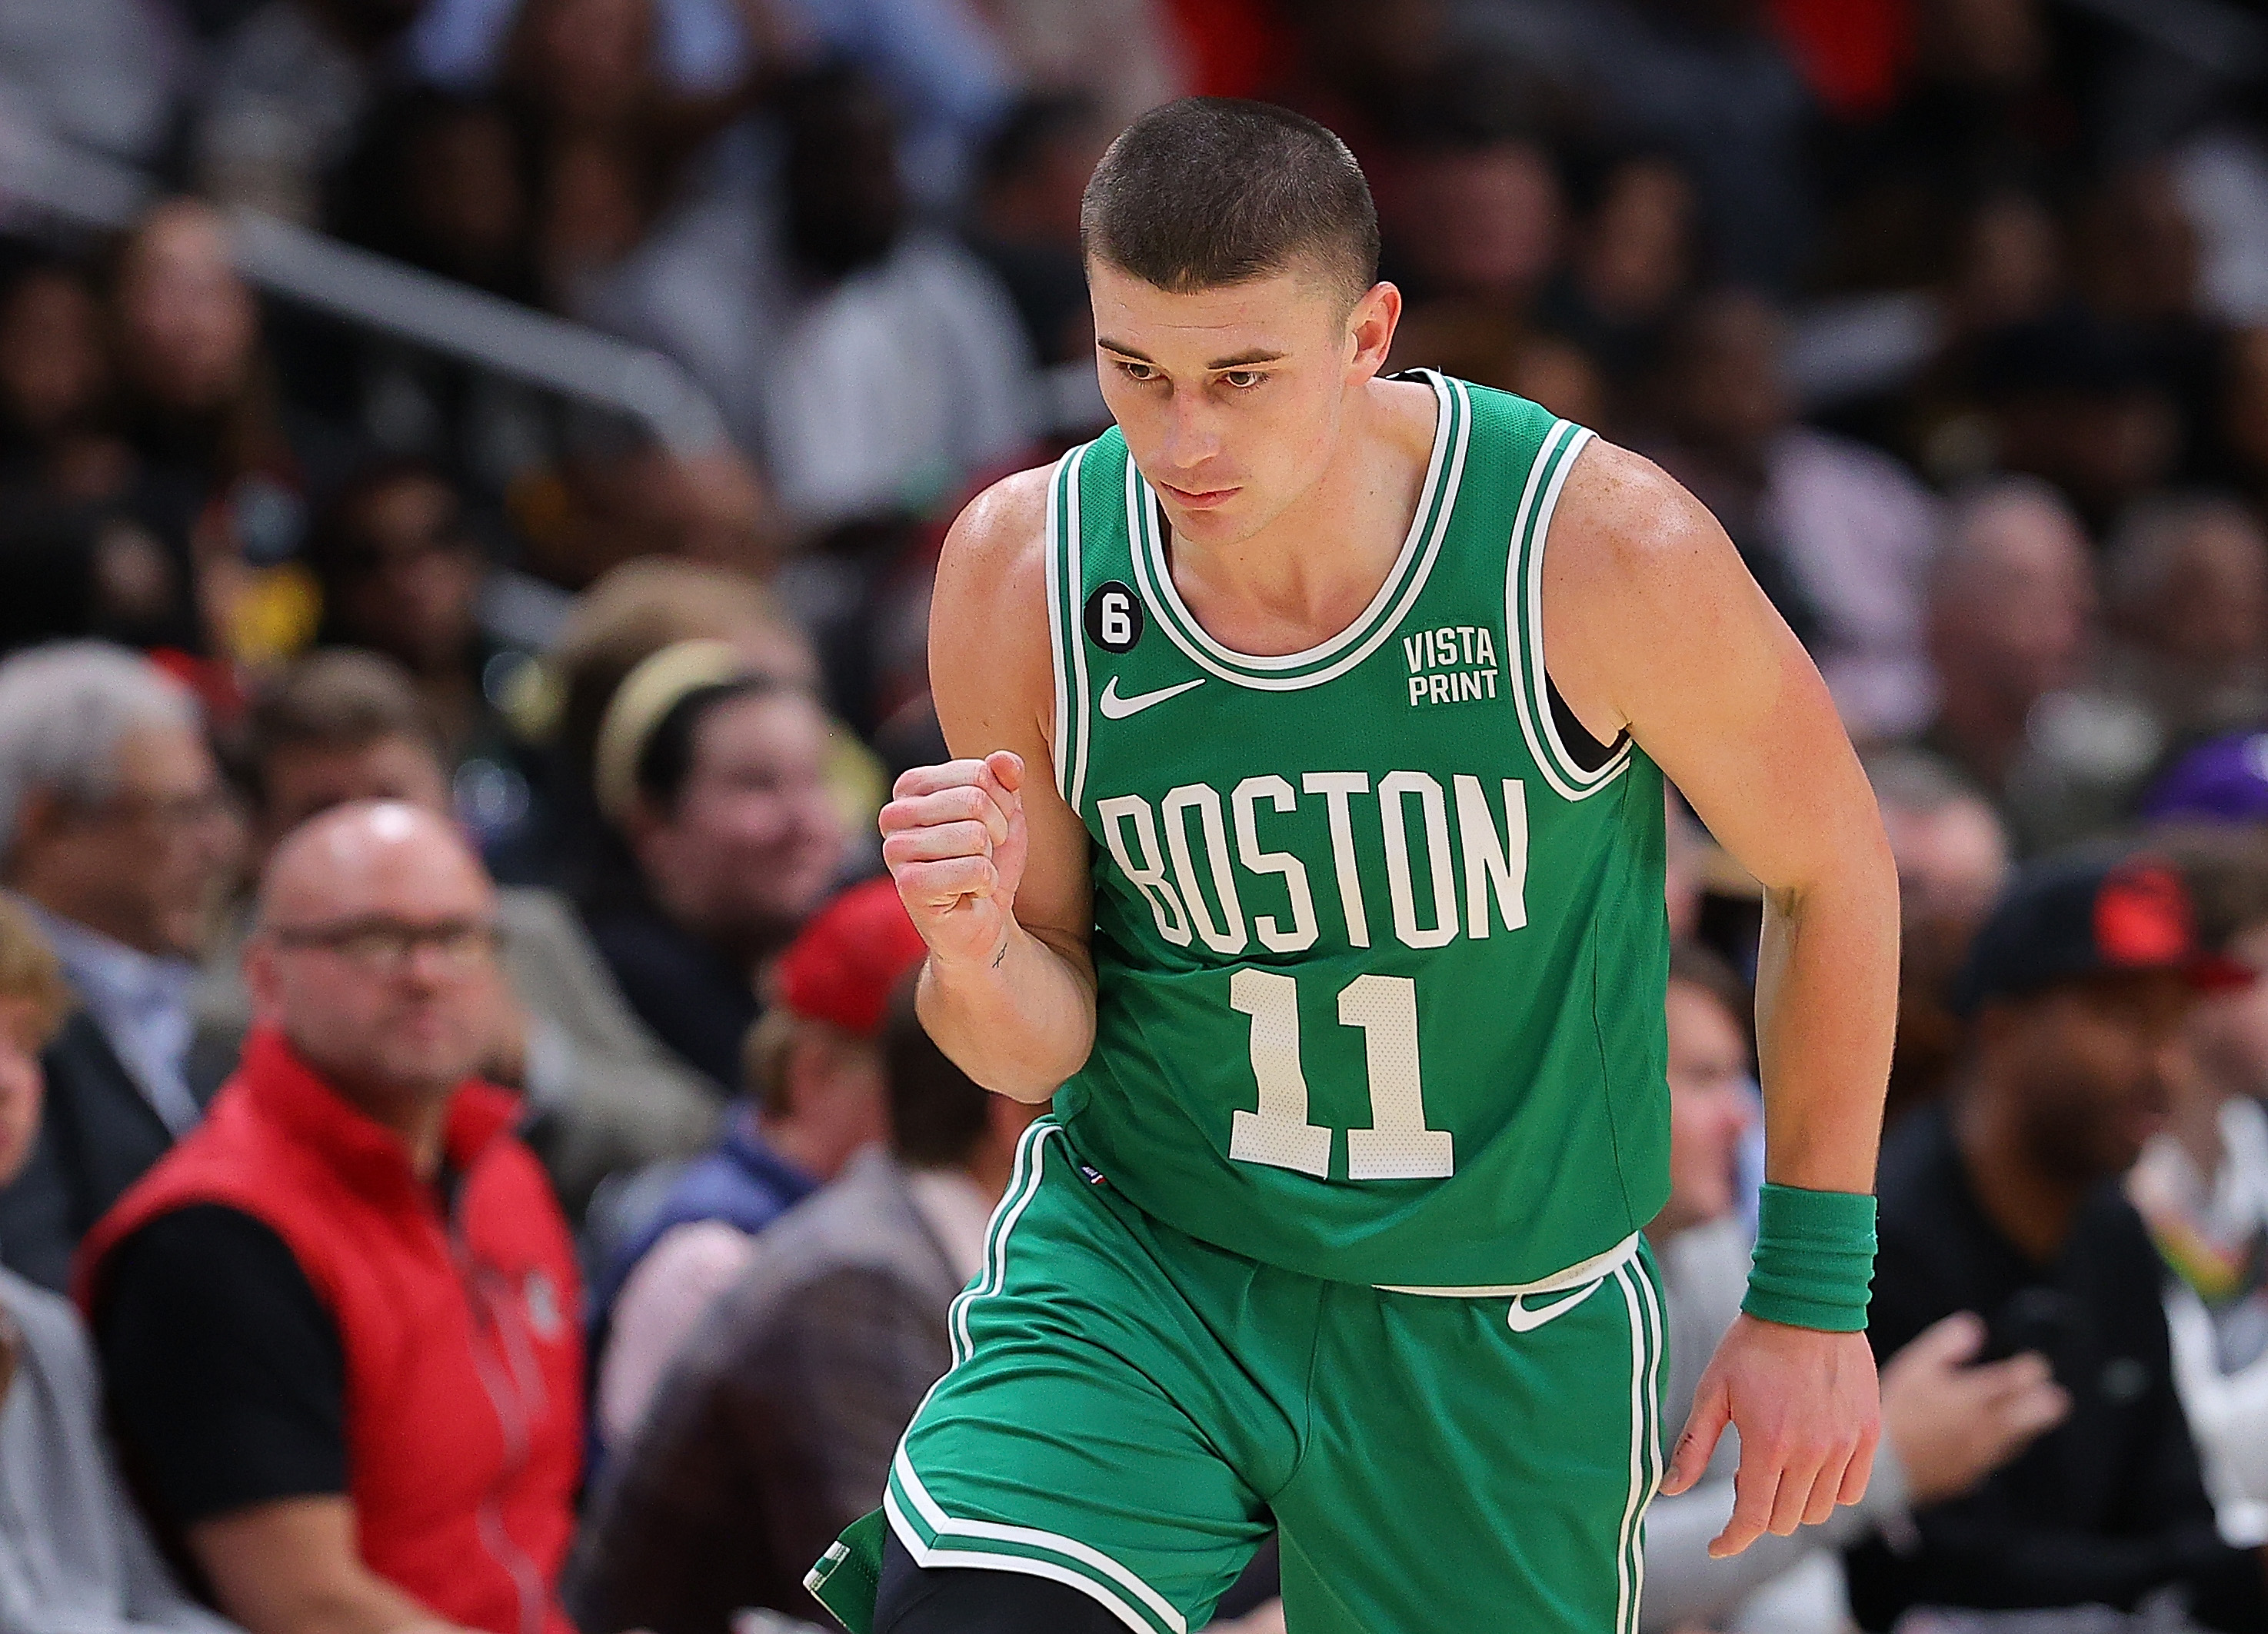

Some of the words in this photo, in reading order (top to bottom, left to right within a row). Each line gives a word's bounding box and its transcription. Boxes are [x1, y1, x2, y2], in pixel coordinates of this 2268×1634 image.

[1101, 593, 1131, 644] 6
[1403, 627, 1497, 674] VISTA
[1409, 669, 1499, 707] PRINT
[1097, 770, 1529, 954] BOSTON
[1229, 967, 1454, 1180] 11
